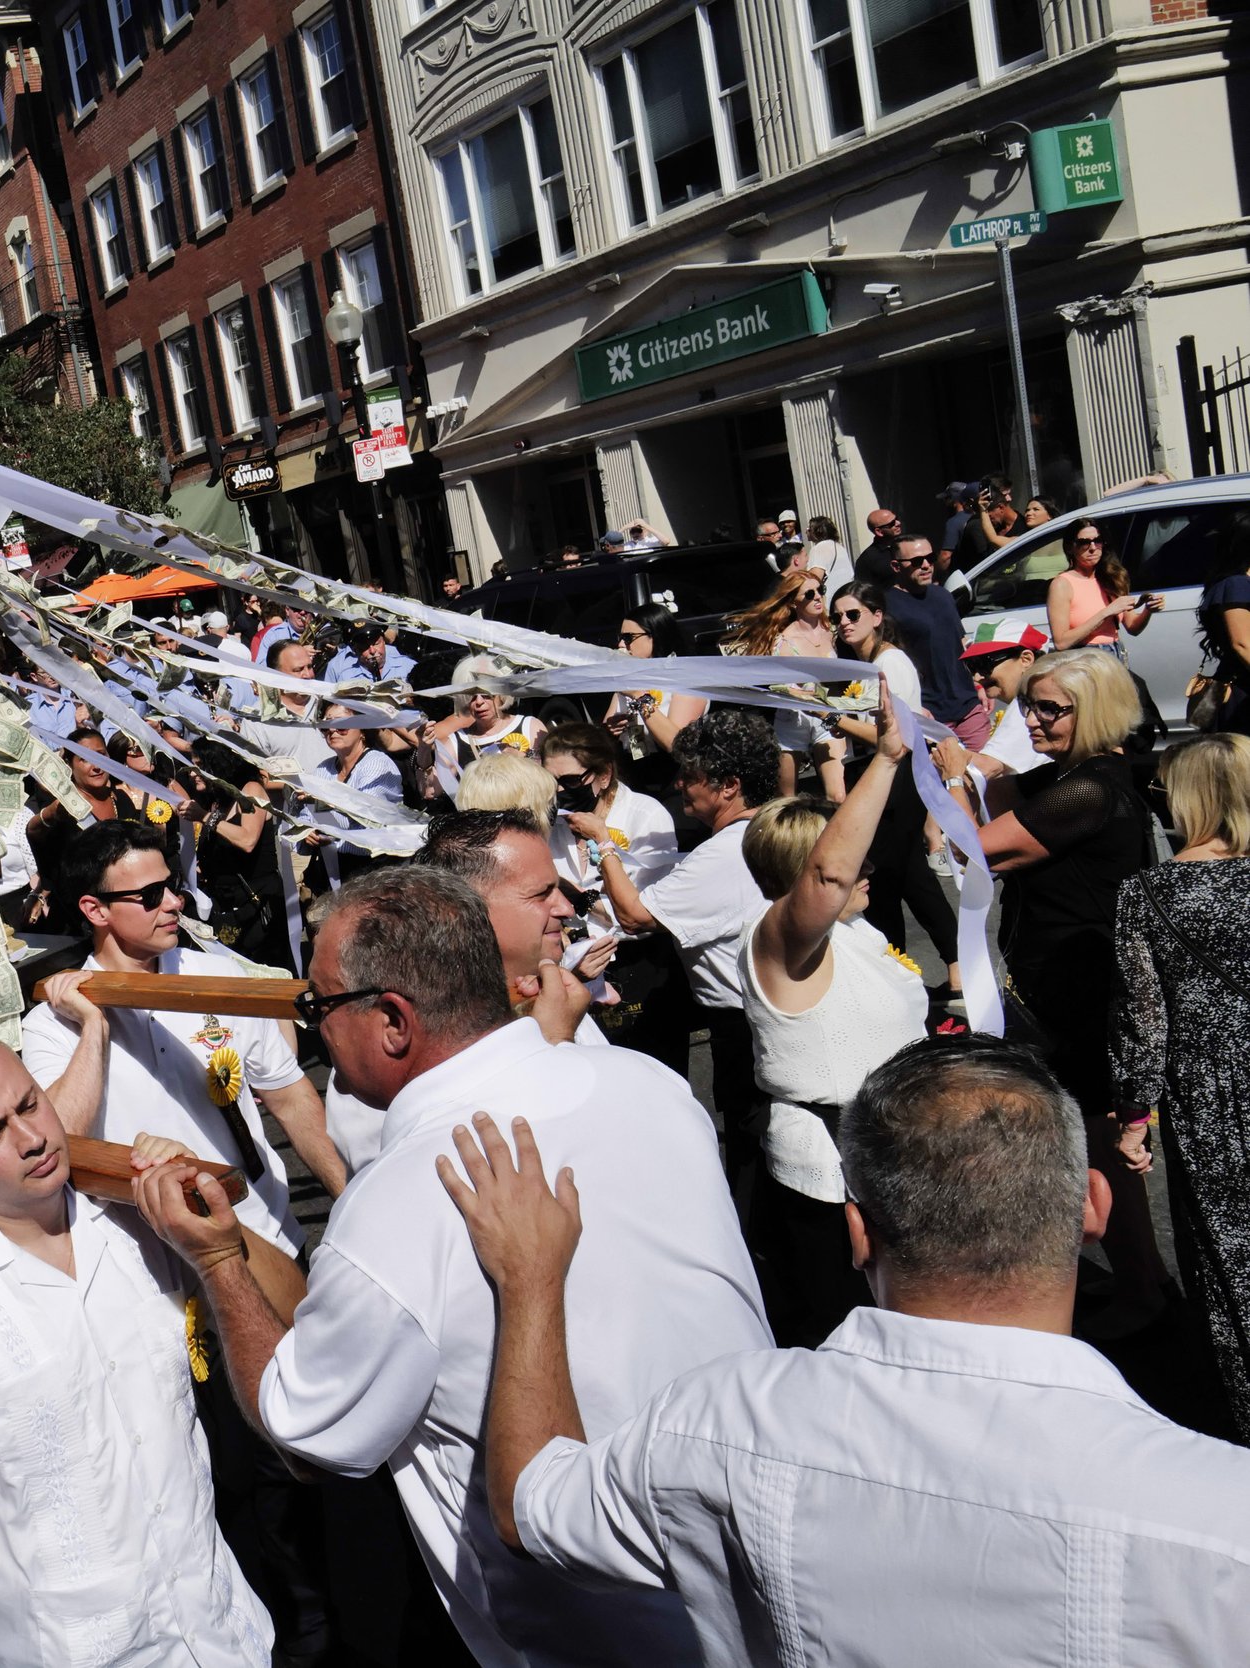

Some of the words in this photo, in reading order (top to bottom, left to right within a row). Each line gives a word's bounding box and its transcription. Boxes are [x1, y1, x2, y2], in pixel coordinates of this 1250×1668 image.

[1064, 161, 1111, 179] Citizens
[1075, 175, 1106, 194] Bank
[960, 218, 1012, 243] LATHROP
[1013, 220, 1024, 234] PL
[638, 332, 714, 369] Citizens
[717, 304, 771, 344] Bank
[231, 467, 274, 489] AMARO
